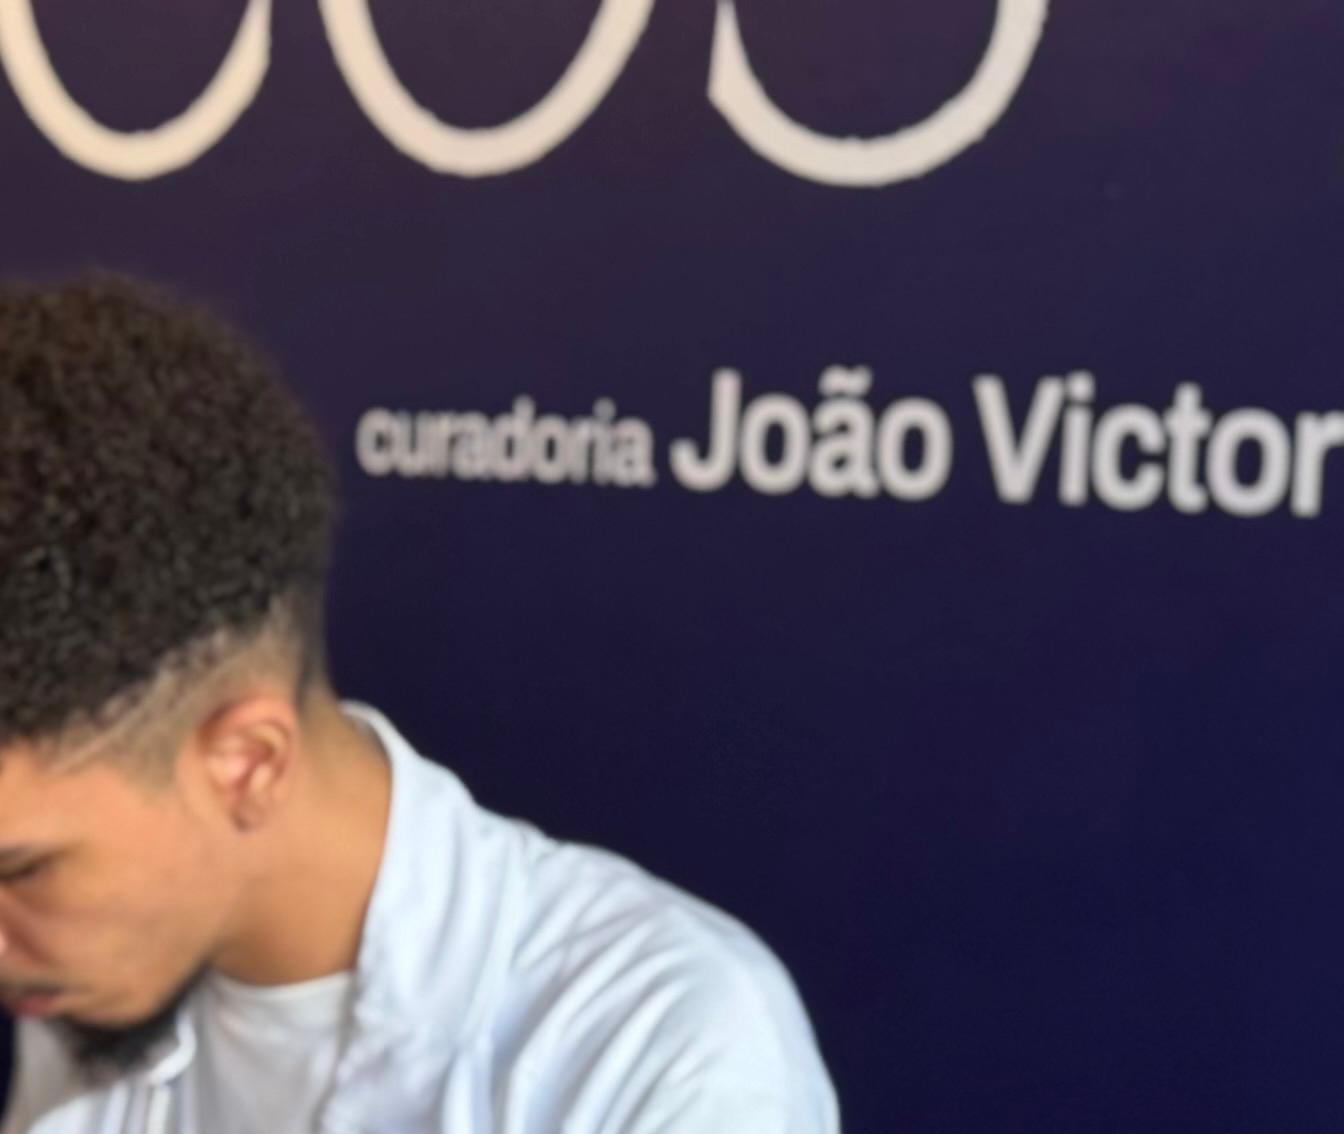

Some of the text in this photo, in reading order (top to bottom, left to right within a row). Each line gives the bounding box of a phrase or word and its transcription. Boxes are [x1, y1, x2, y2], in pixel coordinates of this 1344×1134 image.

[355, 364, 1344, 518] curadoria João Victor
